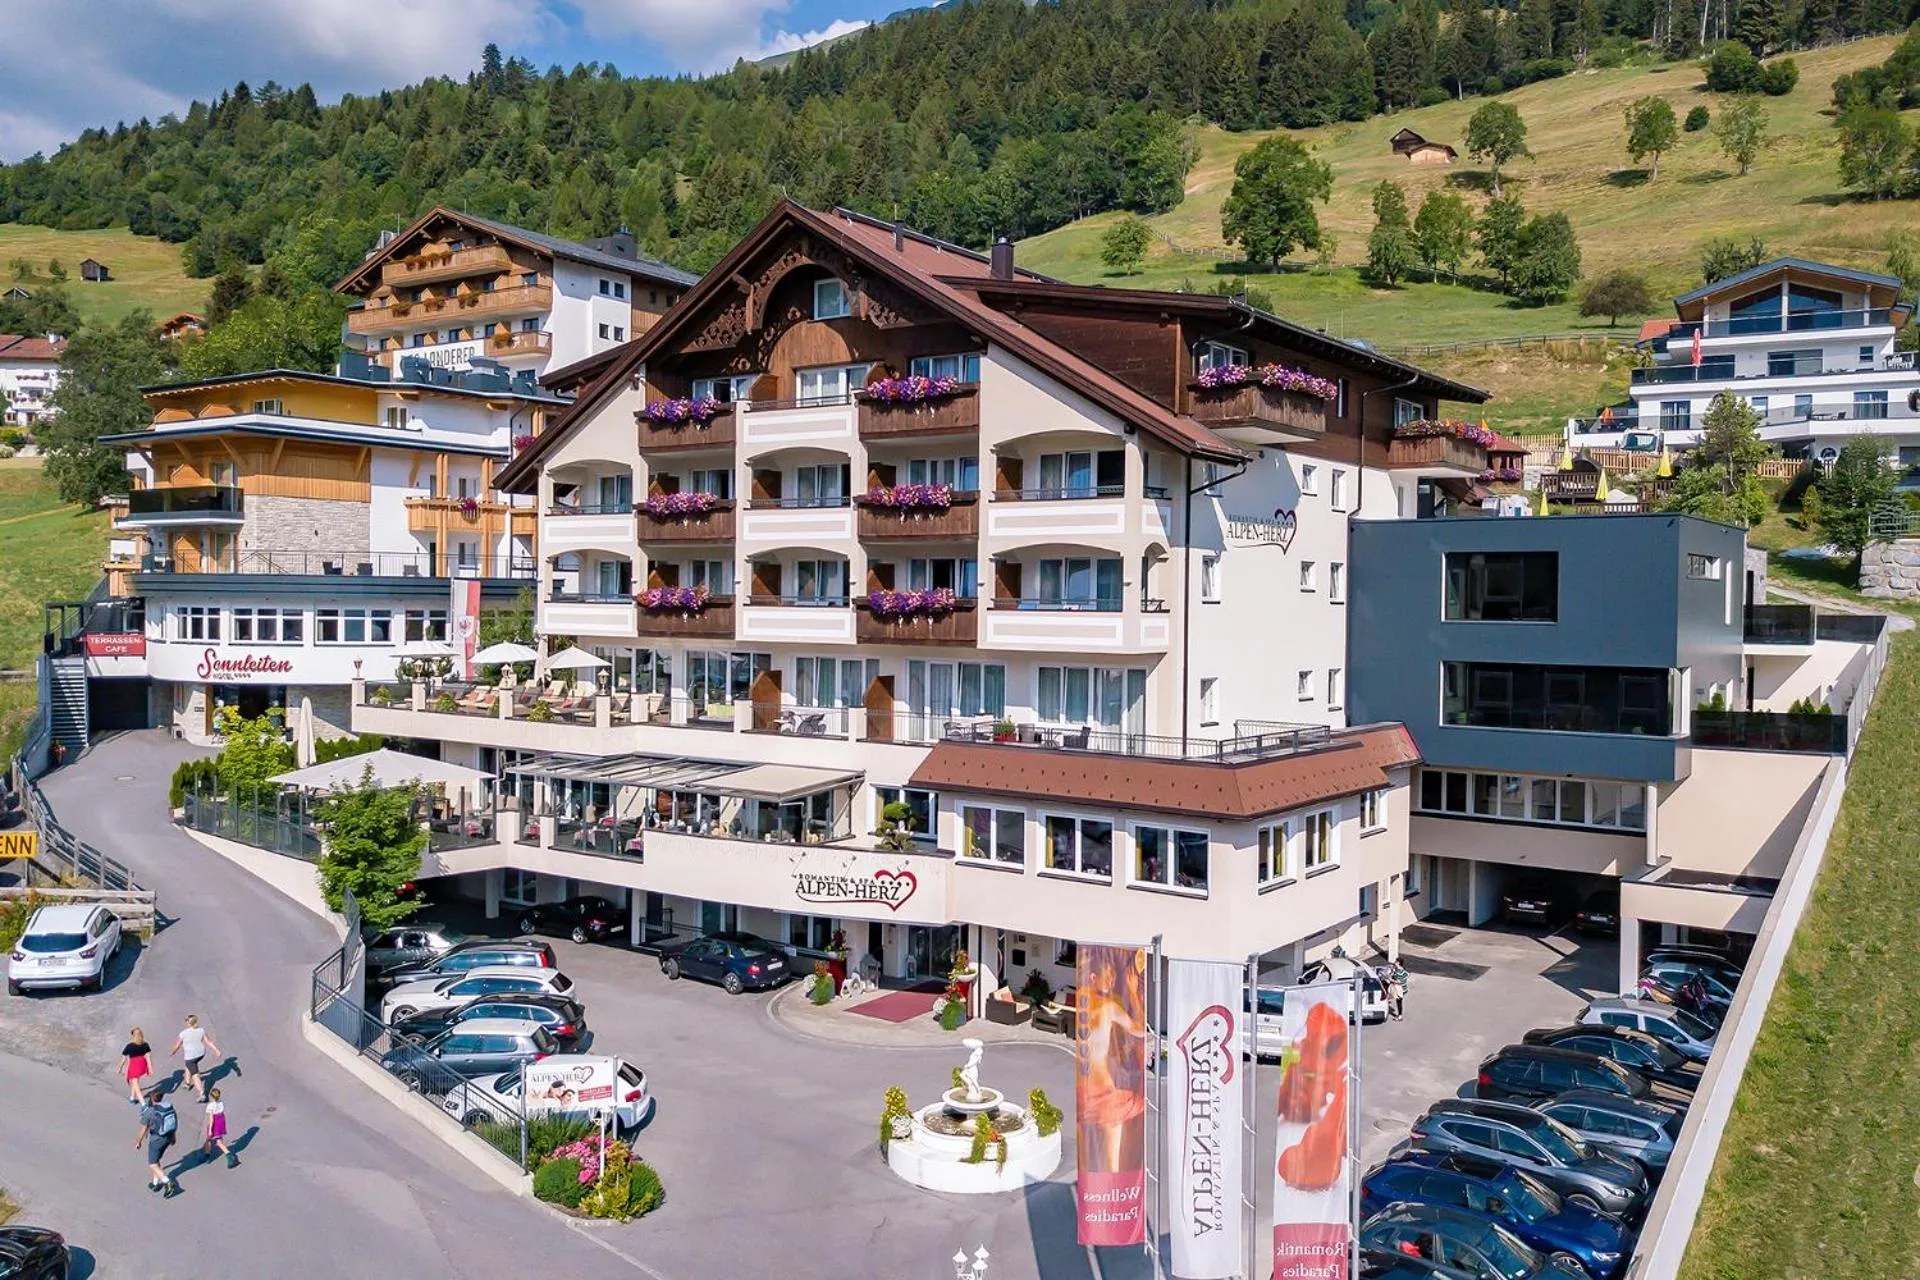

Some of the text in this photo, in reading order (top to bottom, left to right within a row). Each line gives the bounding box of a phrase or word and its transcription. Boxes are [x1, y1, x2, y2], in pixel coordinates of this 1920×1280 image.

[1226, 521, 1288, 542] ALPEN-HERZ
[197, 648, 293, 678] Sonnleiten
[799, 873, 847, 883] ROMANTIK
[796, 880, 900, 901] ALPEN-HERZ
